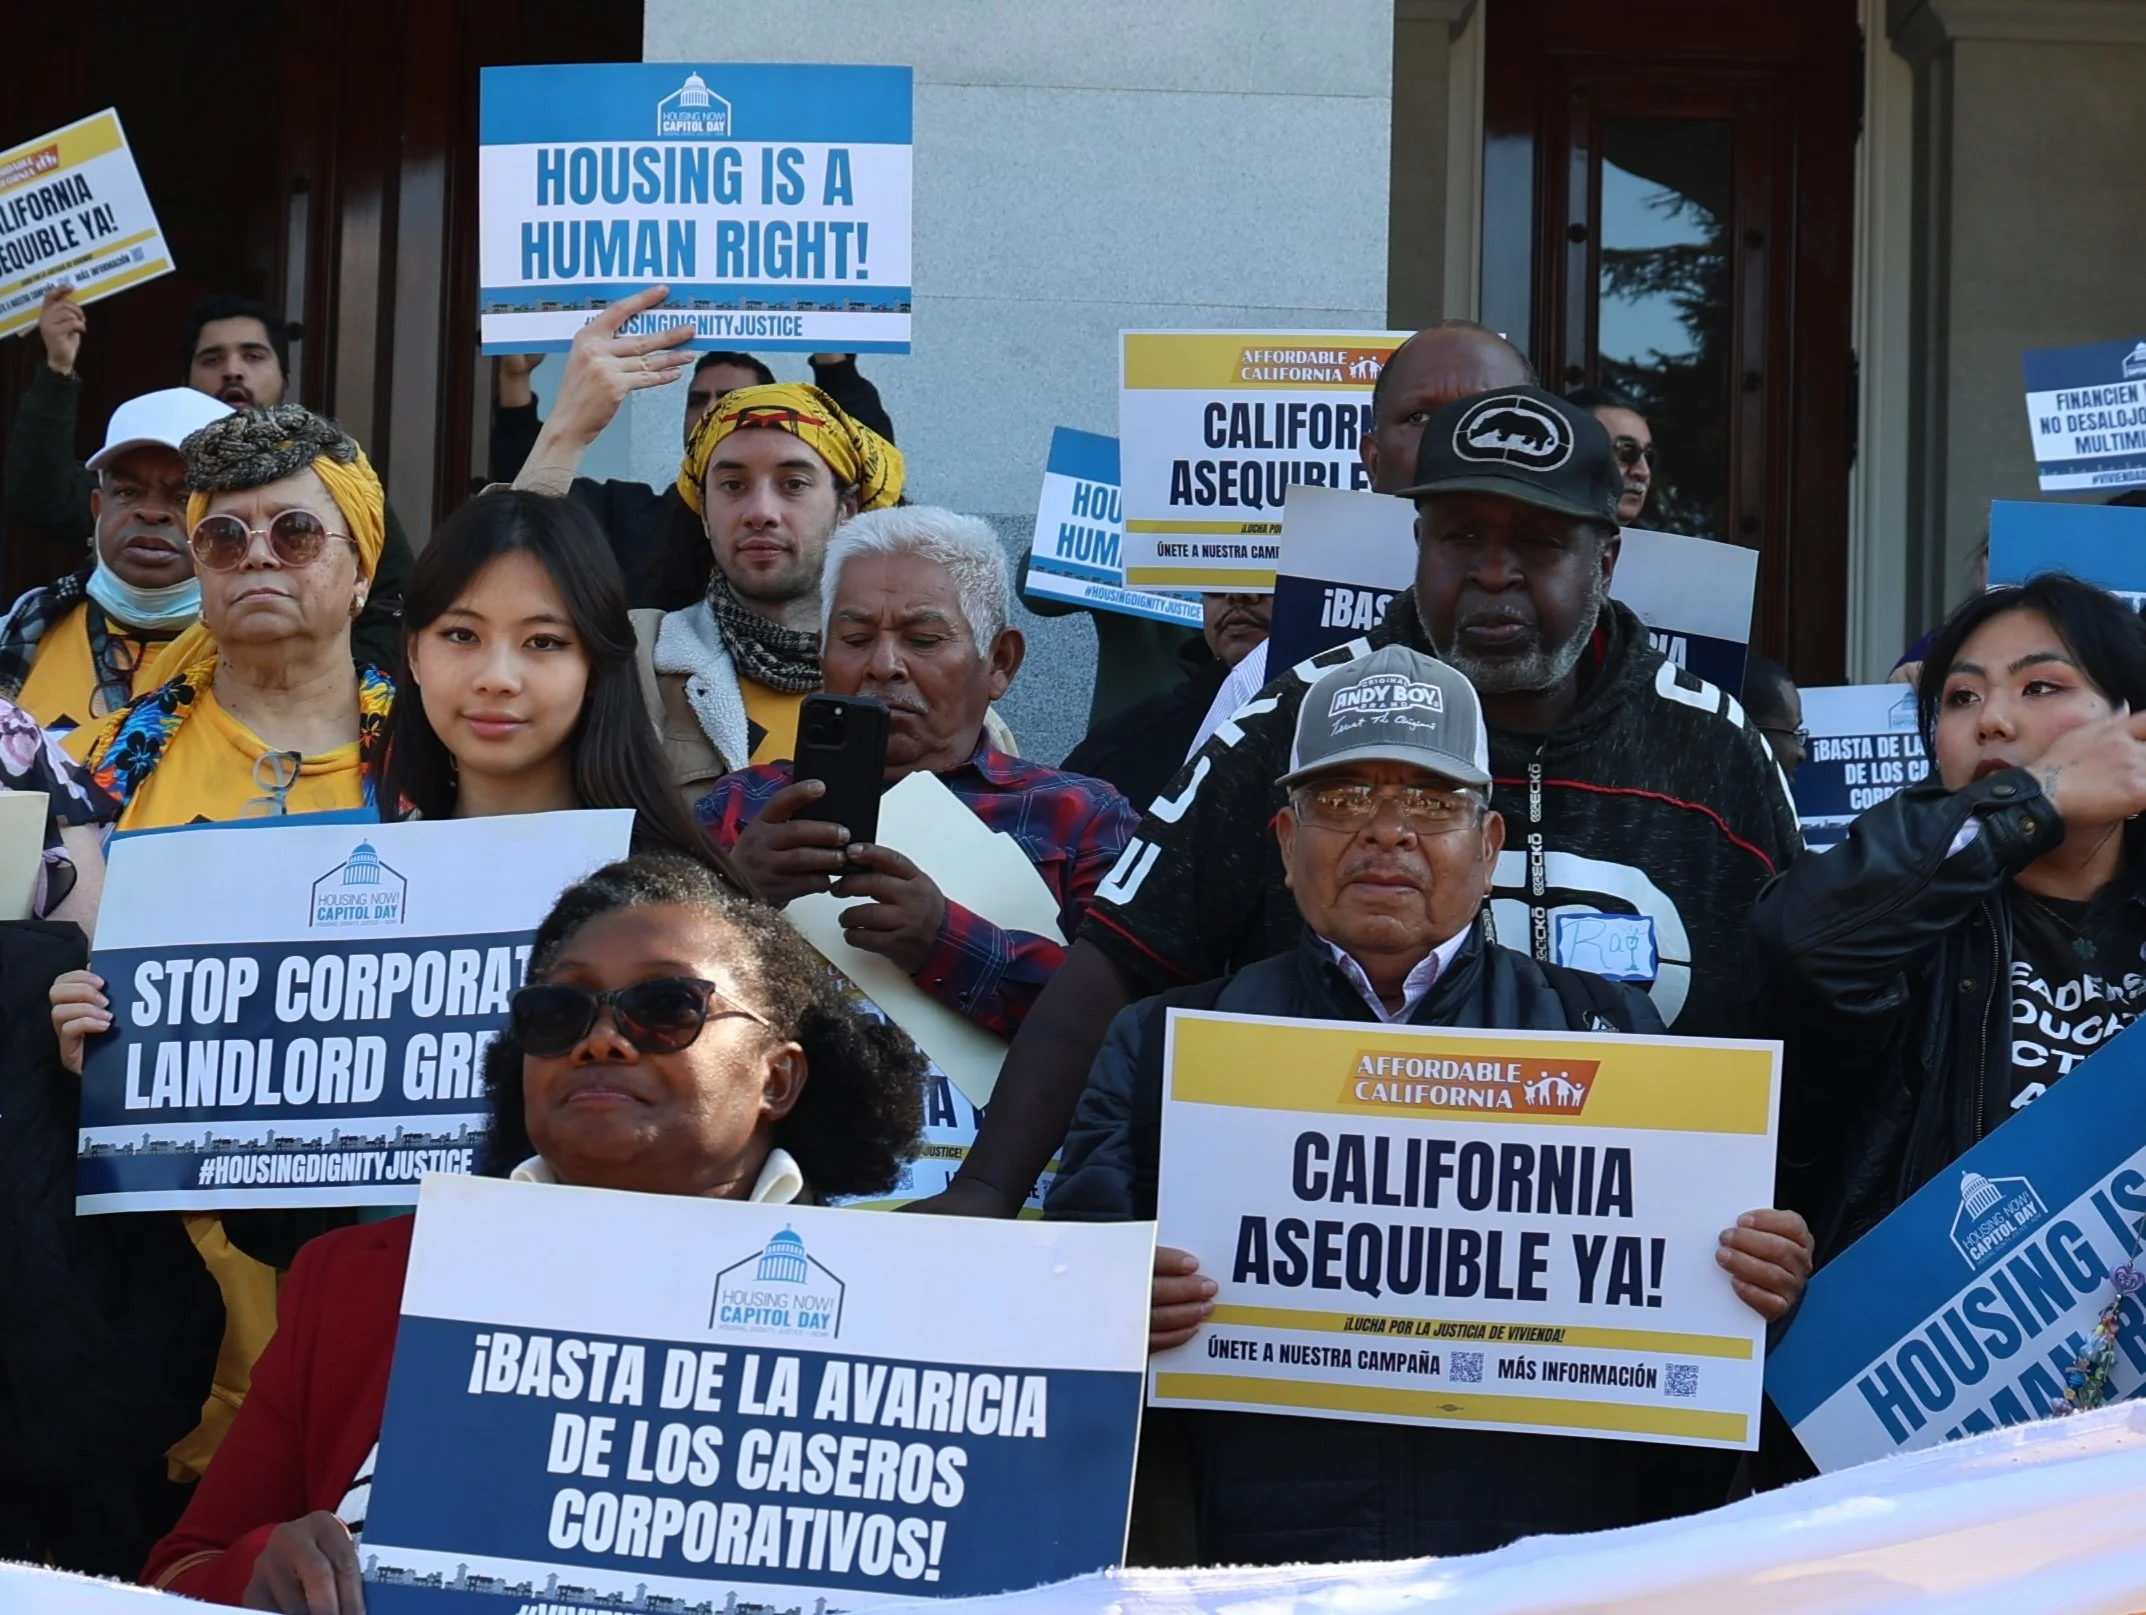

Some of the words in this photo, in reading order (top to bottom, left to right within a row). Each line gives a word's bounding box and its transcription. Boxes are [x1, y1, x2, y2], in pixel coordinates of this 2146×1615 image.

[662, 121, 704, 132] CAPITOL
[707, 121, 726, 132] DAY
[537, 146, 743, 206] HOUSING
[761, 147, 805, 206] IS
[823, 148, 853, 206] A
[0, 173, 93, 235] LIFORNIA
[0, 218, 80, 277] EQUIBLE
[78, 203, 119, 240] YA!
[521, 219, 696, 281] HUMAN
[716, 220, 868, 280] RIGHT!
[1241, 367, 1343, 382] CALIFORNIA
[1242, 350, 1348, 365] AFFORDABLE
[2055, 383, 2140, 412] FINANCIEN
[1203, 402, 1373, 450] CALIFOR
[2040, 415, 2062, 435] NO
[1055, 523, 1122, 569] HUM
[1157, 541, 1189, 558] ÚNETE
[1191, 544, 1199, 558] A
[1202, 544, 1248, 559] NUESTRA
[1084, 585, 1201, 619] #HOUSINGDIGNITYJUSTICE
[1320, 587, 1394, 631] ¡BAS
[1334, 685, 1391, 711] ANDY
[1361, 701, 1409, 709] BRAND
[1813, 737, 1873, 763] ¡BASTA
[1877, 737, 1900, 758] DE
[1904, 735, 1926, 757] LA
[1844, 762, 1868, 786] DE
[1871, 761, 1904, 785] LOS
[317, 906, 370, 921] CAPITOL
[374, 904, 399, 919] DAY
[318, 893, 368, 907] HOUSING
[370, 891, 400, 905] NOW!
[131, 956, 259, 1027] STOP
[275, 944, 534, 1022] CORPORAT
[125, 1036, 388, 1110] LANDLORD
[1357, 1055, 1523, 1083] AFFORDABLE
[1354, 1081, 1513, 1109] CALIFORNIA
[198, 1148, 473, 1186] #HOUSINGDIGNITYJUSTICE
[1291, 1131, 1634, 1219] CALIFORNIA
[1962, 1212, 2005, 1249] HOUSING
[2003, 1191, 2031, 1217] NOW!
[1969, 1220, 2017, 1260] CAPITOL
[2013, 1201, 2037, 1225] DAY
[1232, 1215, 1549, 1302] ASEQUIBLE
[1572, 1233, 1667, 1309] YA!
[720, 1306, 791, 1327] CAPITOL
[798, 1311, 831, 1330] DAY
[722, 1289, 788, 1309] HOUSING
[793, 1295, 834, 1313] NOW!
[1343, 1316, 1386, 1334] ¡LUCHA
[1388, 1319, 1413, 1335] POR
[1415, 1320, 1431, 1336] LA
[1433, 1321, 1487, 1340] JUSTICIA
[1488, 1325, 1506, 1341] DE
[1507, 1326, 1566, 1344] VIVIENDA!
[1857, 1220, 2112, 1446] HOUSING
[1207, 1334, 1258, 1361] ÚNETE
[1262, 1344, 1274, 1363] A
[1279, 1345, 1353, 1369] NUESTRA
[1357, 1349, 1441, 1376] CAMPAÑA
[1498, 1355, 1537, 1381] MÁS
[1541, 1360, 1658, 1389] INFORMACIÓN
[468, 1332, 647, 1407] ¡BASTA
[661, 1348, 726, 1413] DE
[738, 1353, 805, 1420] LA
[814, 1361, 1048, 1439] AVARICIA
[547, 1413, 612, 1478] DE
[627, 1419, 721, 1487] LOS
[736, 1429, 968, 1508] CASEROS
[548, 1488, 945, 1581] CORPORATIVOS!
